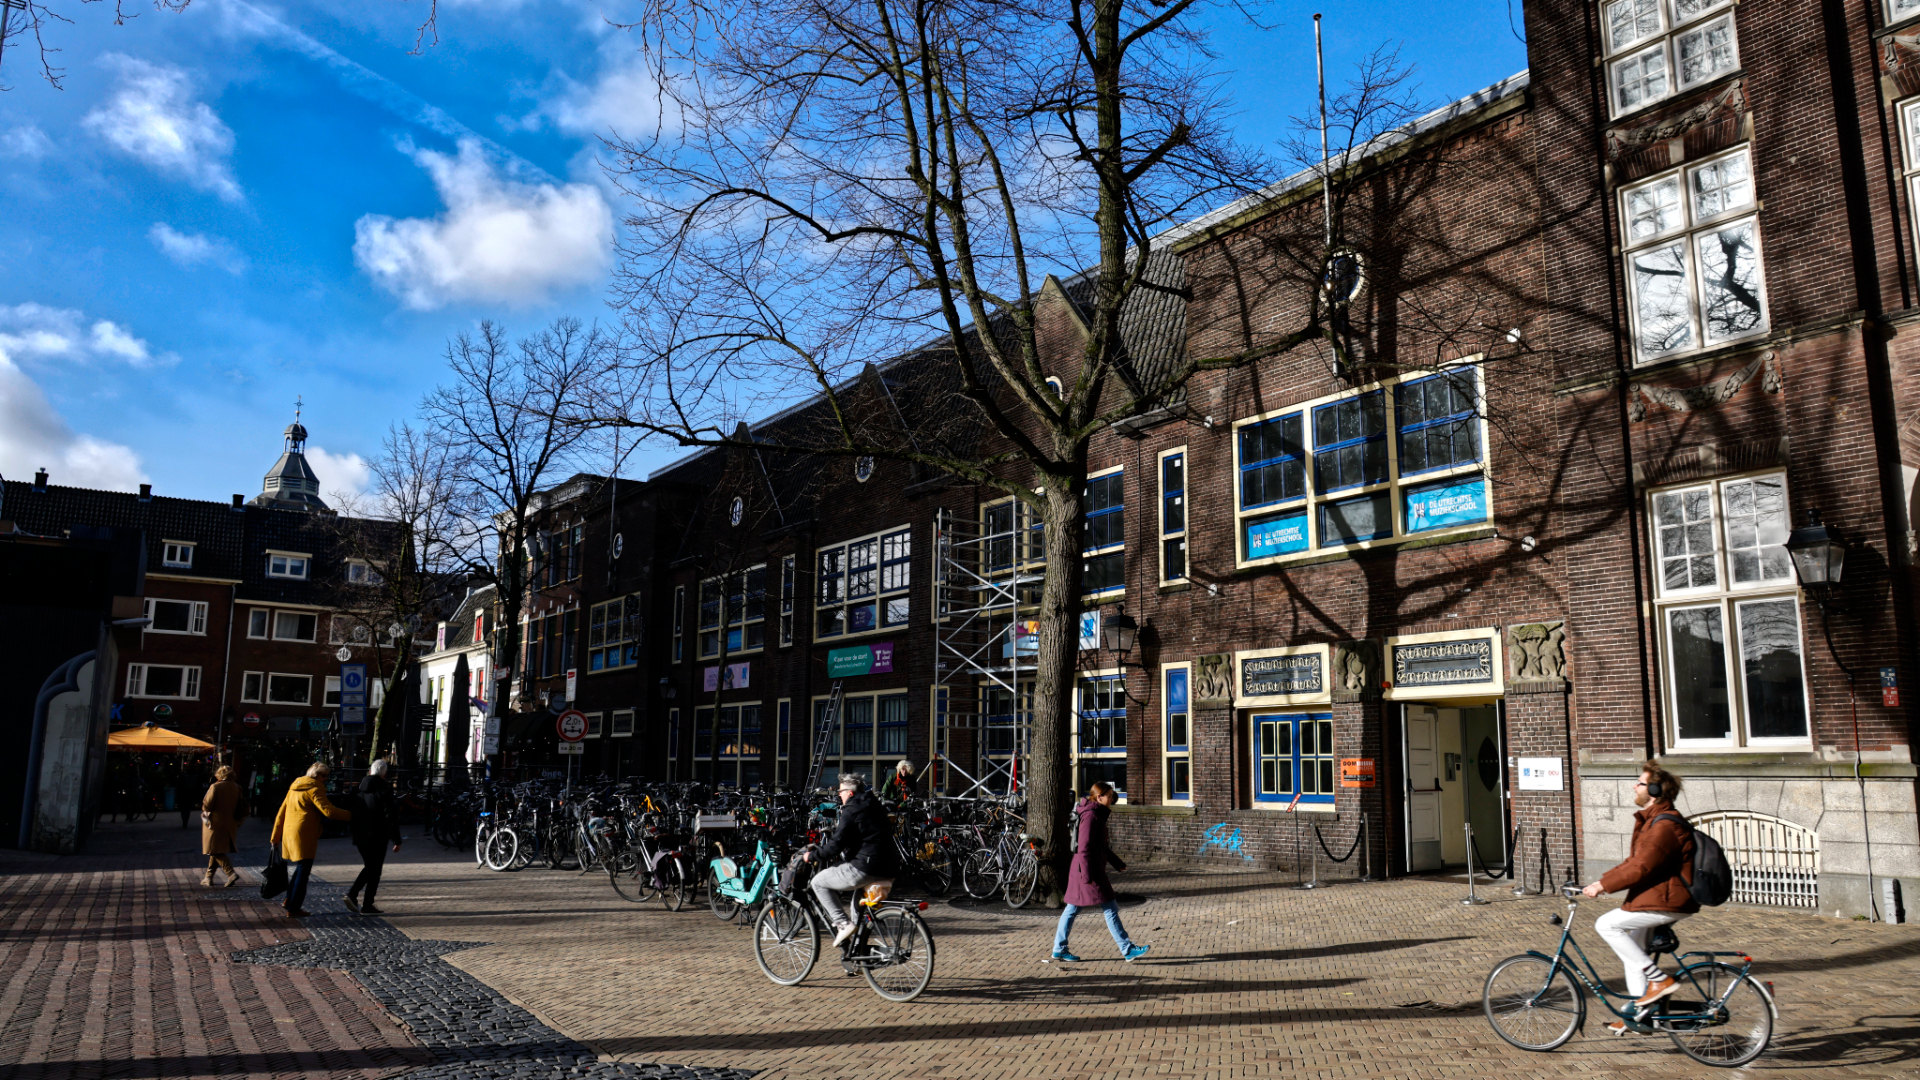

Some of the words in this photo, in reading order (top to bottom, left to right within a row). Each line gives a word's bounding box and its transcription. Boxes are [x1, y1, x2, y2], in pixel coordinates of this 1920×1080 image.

[1429, 500, 1437, 508] DE
[1438, 494, 1472, 507] UTRECHTSE
[1429, 501, 1477, 516] MUZIEKSCHOOL
[1272, 526, 1299, 538] UTRECHTSE
[1265, 533, 1303, 546] MUZIEKSCHOOL
[753, 867, 765, 889] TIER
